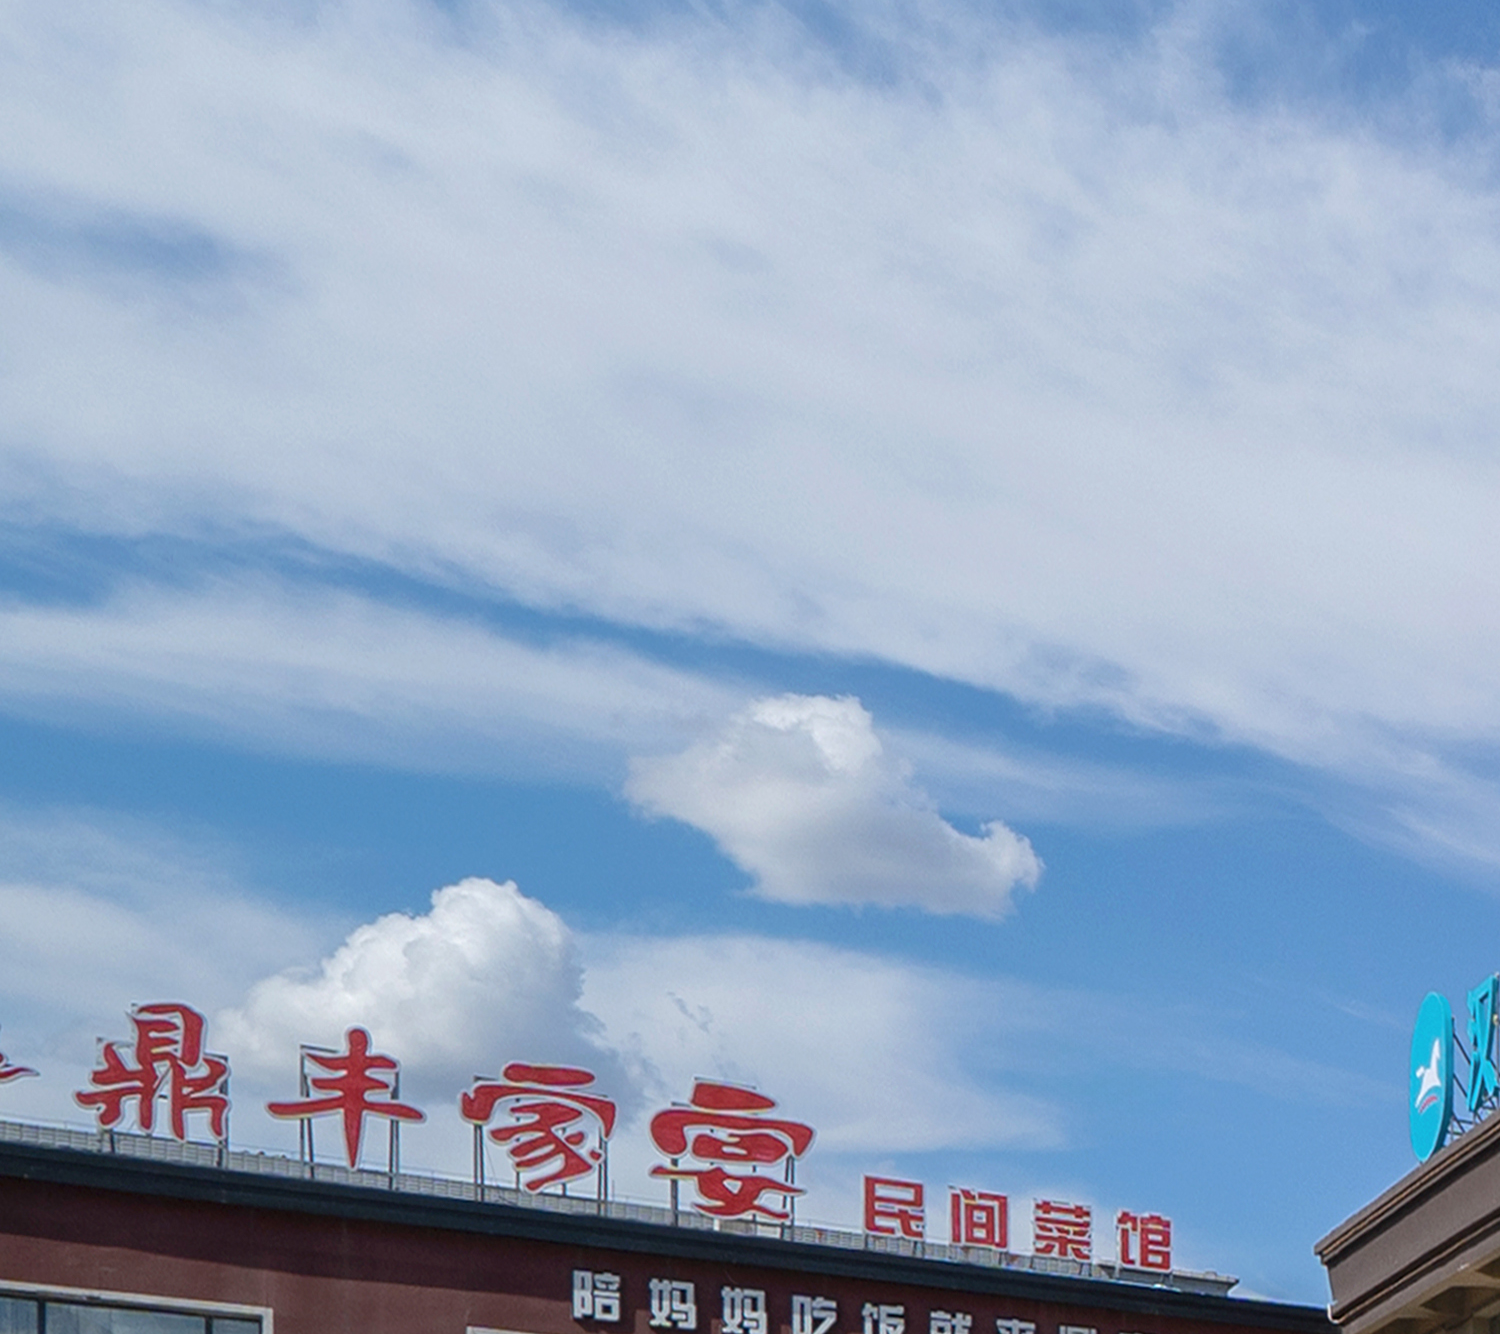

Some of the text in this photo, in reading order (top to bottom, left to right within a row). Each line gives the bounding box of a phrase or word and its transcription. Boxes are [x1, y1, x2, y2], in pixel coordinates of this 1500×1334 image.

[0, 1001, 816, 1220] 鼎丰家宴
[863, 1174, 1173, 1272] 民间菜馆
